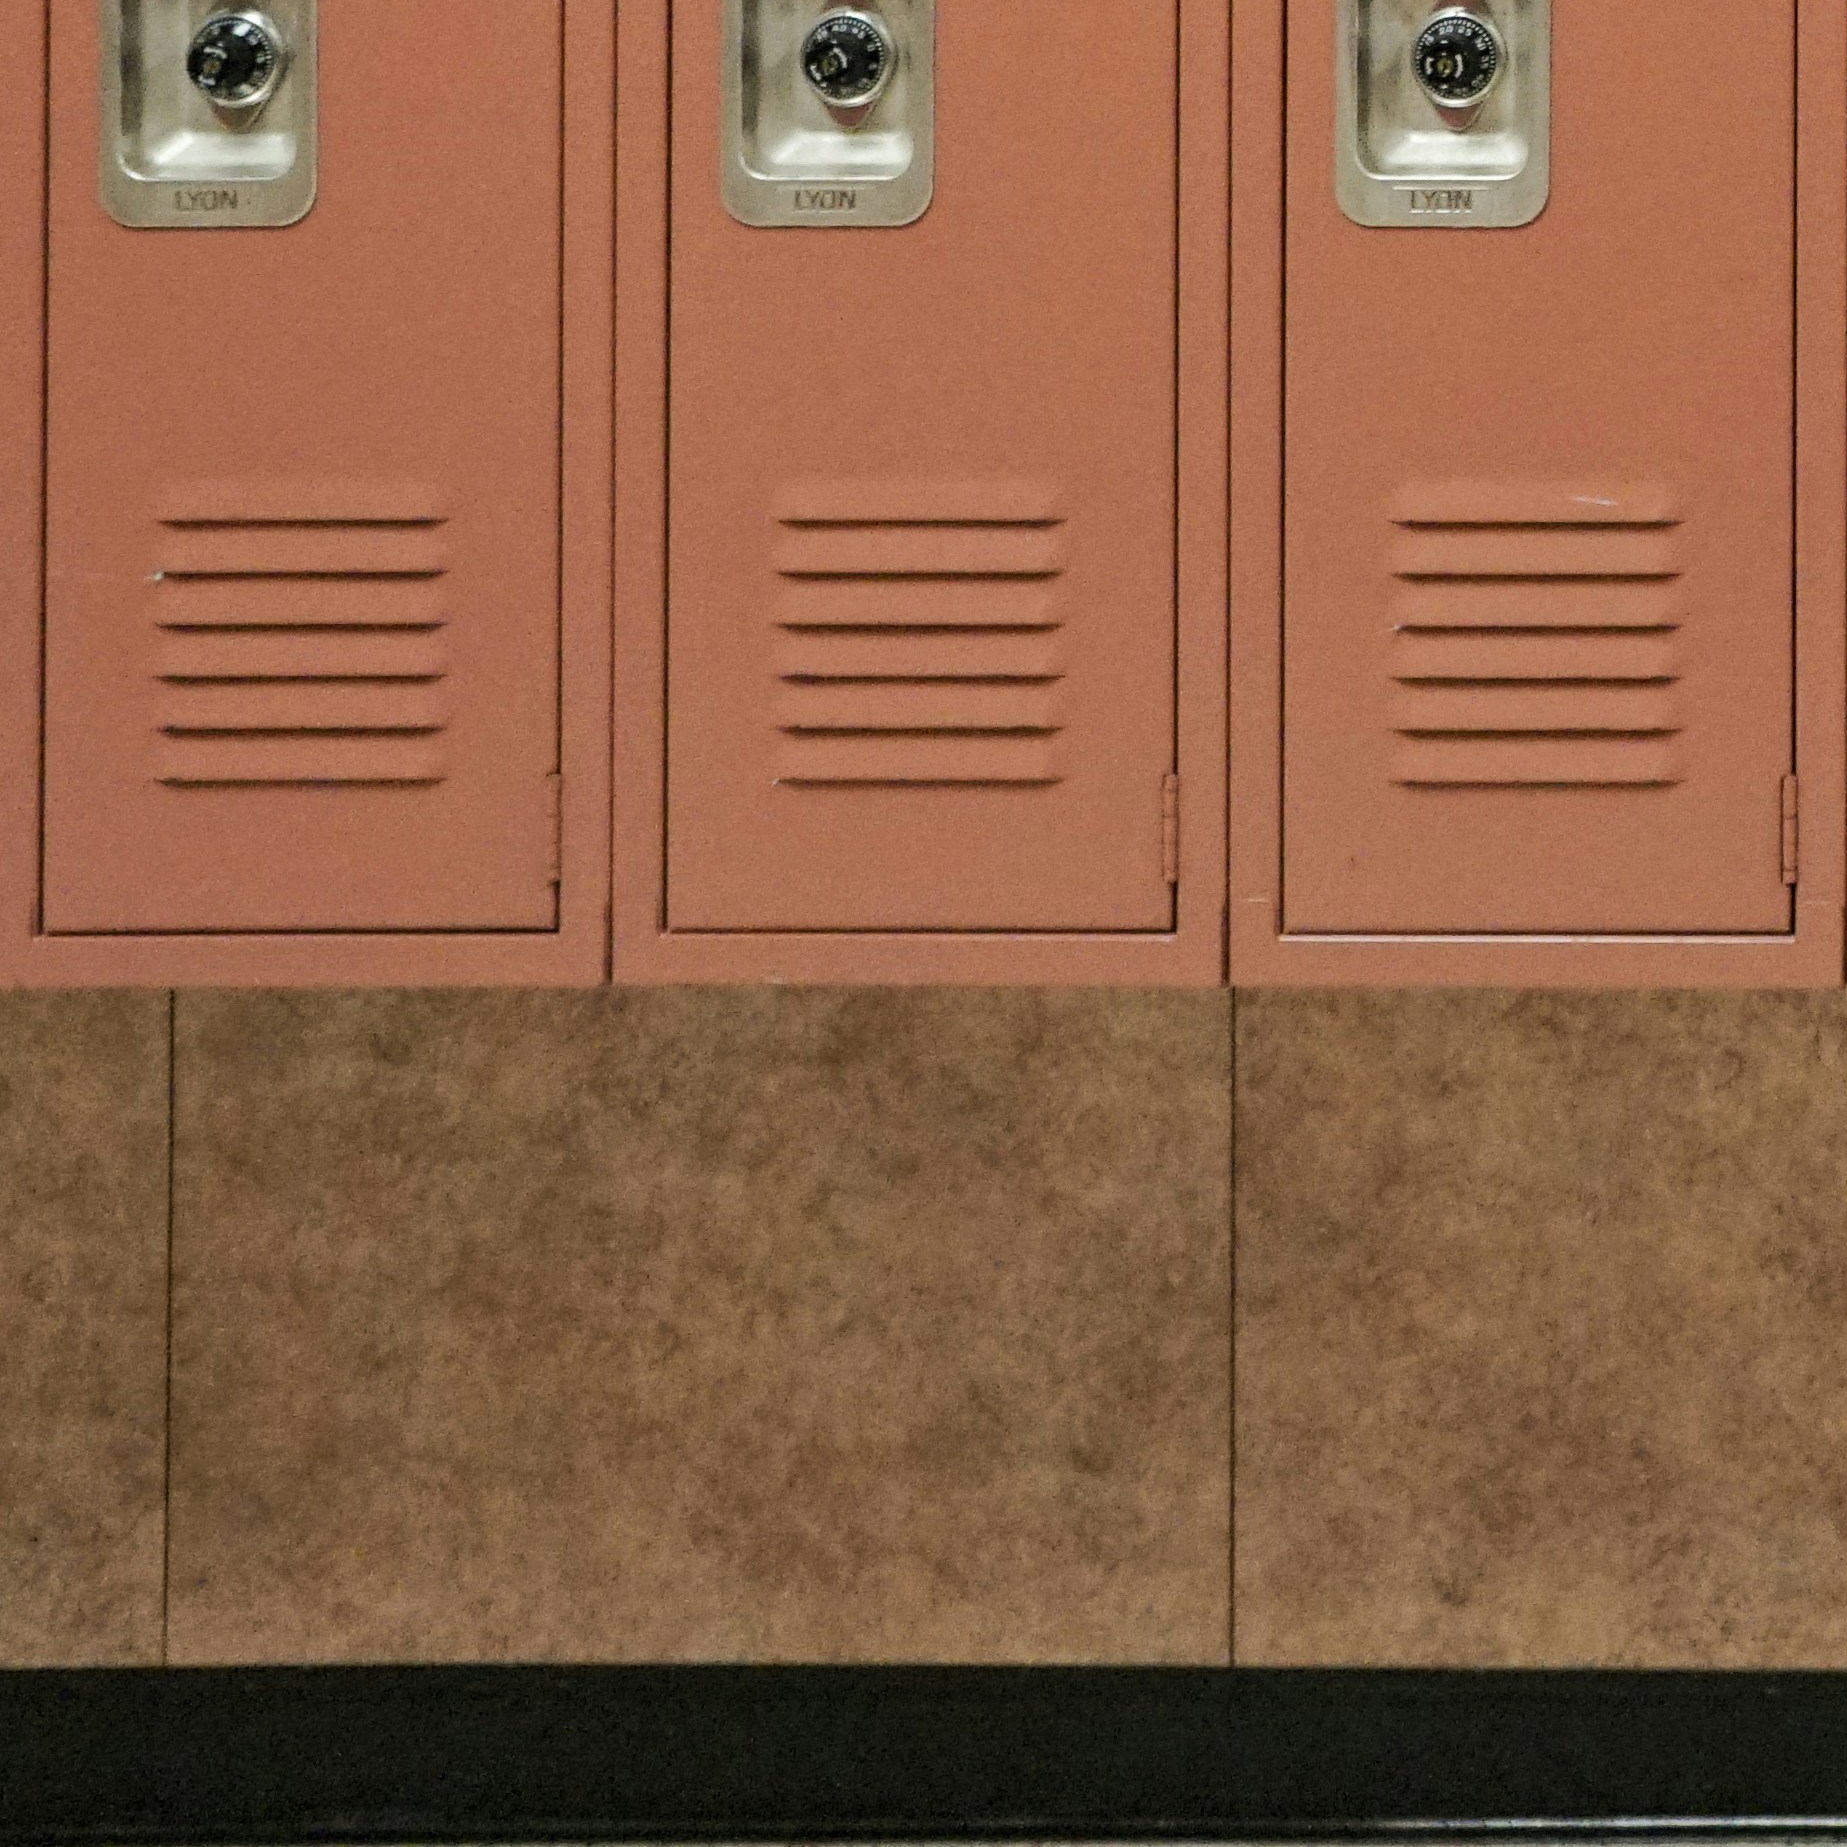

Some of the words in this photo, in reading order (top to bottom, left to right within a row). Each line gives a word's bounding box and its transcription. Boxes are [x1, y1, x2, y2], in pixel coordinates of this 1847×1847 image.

[175, 190, 238, 210] LYON
[794, 190, 856, 209] LYON
[1410, 191, 1472, 210] LYON
